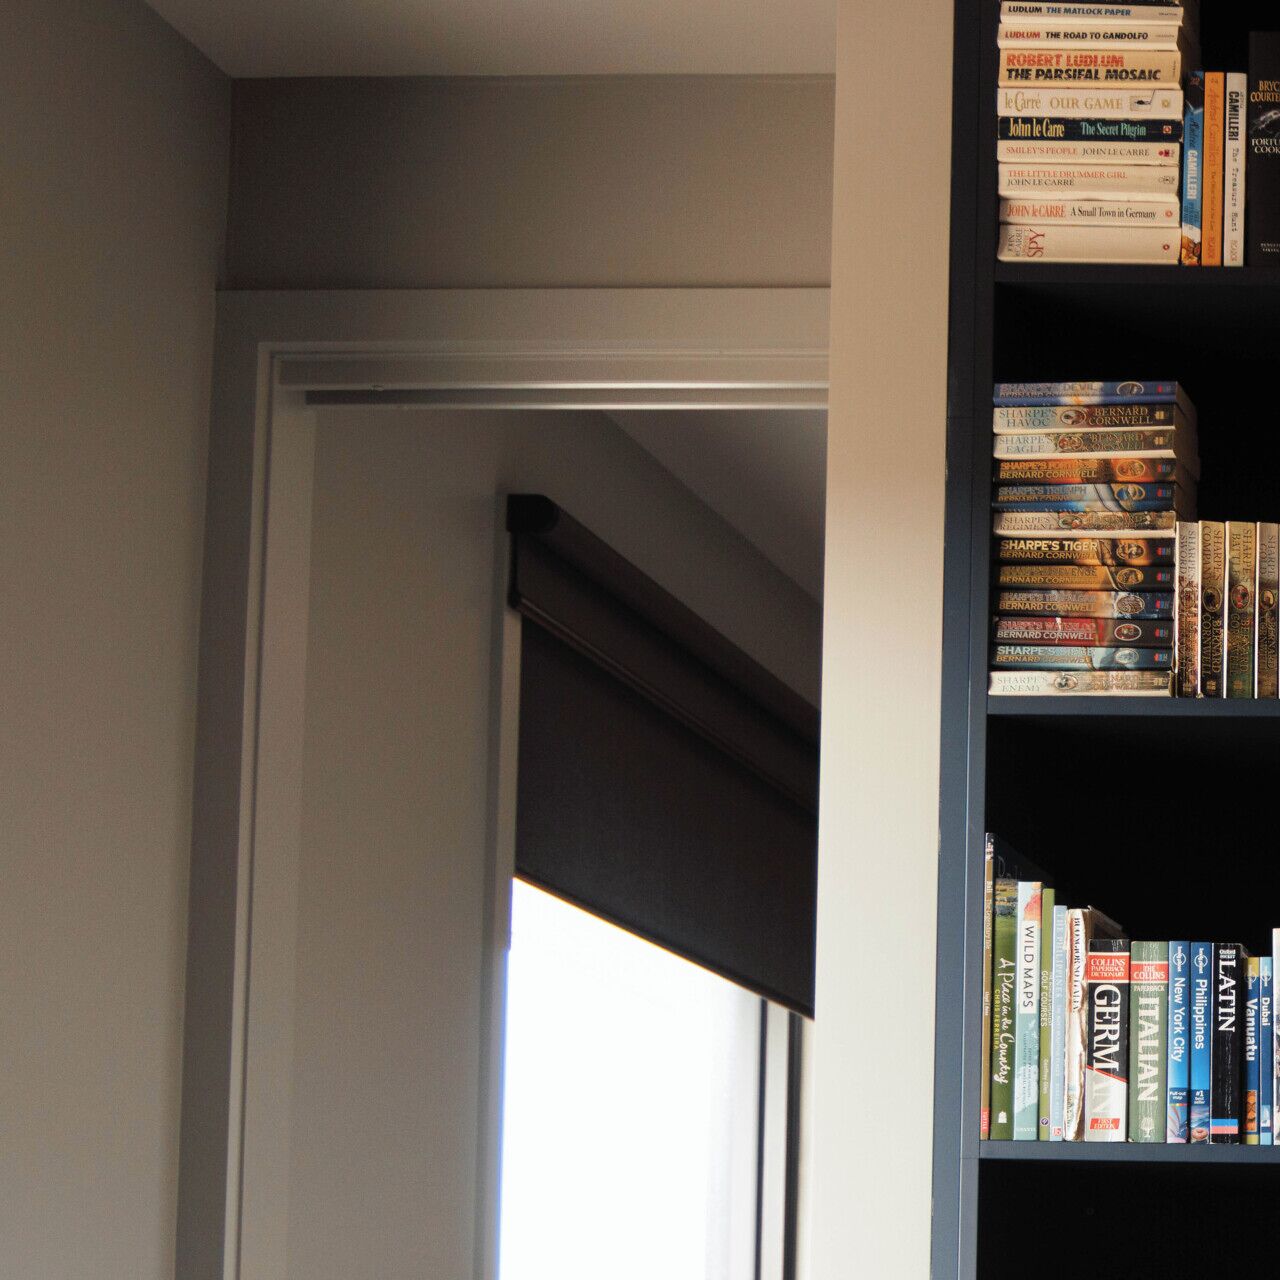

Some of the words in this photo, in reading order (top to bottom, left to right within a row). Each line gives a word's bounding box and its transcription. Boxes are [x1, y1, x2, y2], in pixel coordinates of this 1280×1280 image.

[1006, 54, 1062, 66] ROBERT
[1067, 55, 1125, 67] LUDLUM
[1006, 69, 1031, 80] THE
[1035, 69, 1100, 80] PARSIFAL
[1105, 70, 1161, 80] MOSAIC
[1071, 208, 1076, 217] A
[1077, 207, 1096, 217] Small
[1098, 208, 1116, 217] Town
[1117, 209, 1123, 217] in
[1125, 208, 1157, 219] Germany
[1024, 925, 1034, 963] WILD
[1091, 958, 1125, 967] COLLINS
[1133, 971, 1165, 980] COLLINS
[1023, 968, 1033, 1008] MAPS
[1174, 977, 1186, 1002] New
[1218, 961, 1235, 1032] LATIN
[1173, 1004, 1185, 1034] York
[1195, 979, 1208, 1049] Philippines
[1262, 997, 1270, 1026] Dubai
[1245, 998, 1258, 1061] Vanuatu
[1137, 997, 1159, 1101] ITALIAN
[1170, 1035, 1185, 1062] City
